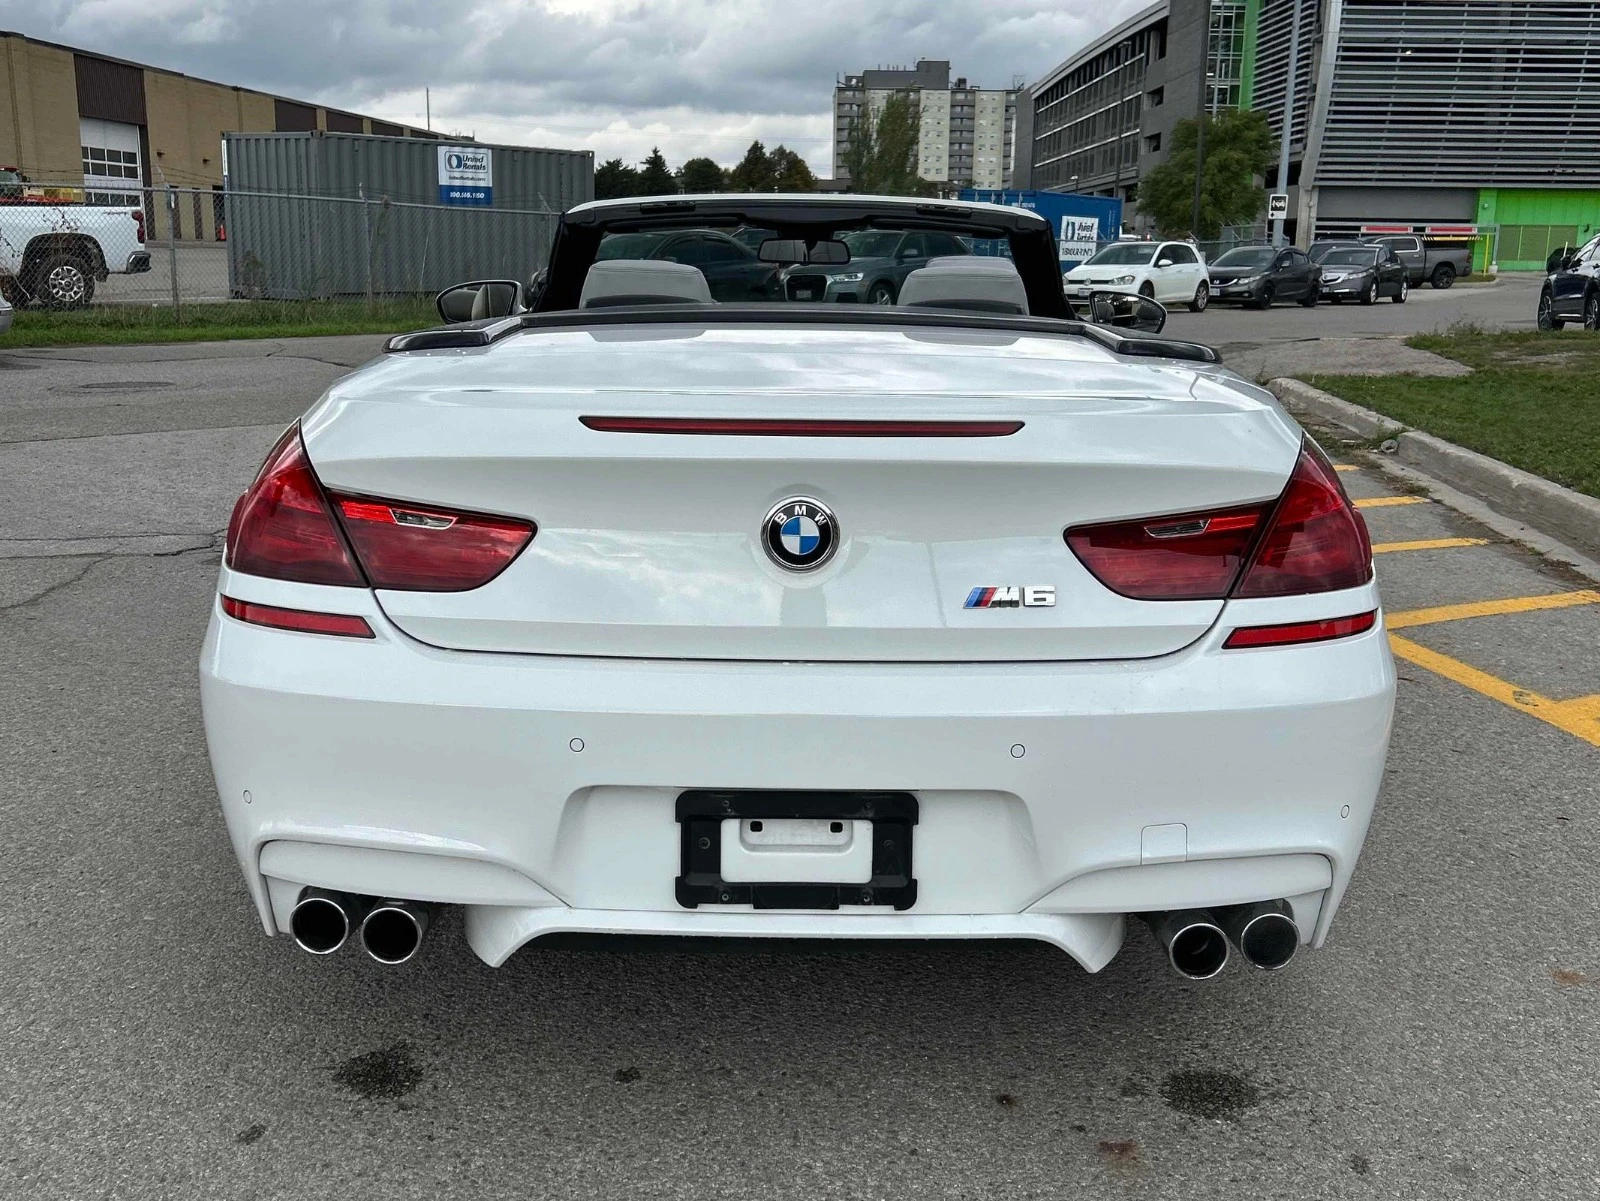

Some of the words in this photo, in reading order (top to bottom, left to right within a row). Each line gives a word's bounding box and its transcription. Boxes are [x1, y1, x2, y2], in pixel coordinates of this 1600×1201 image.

[462, 154, 484, 163] United
[774, 505, 827, 526] BMW
[985, 585, 1056, 608] M6
